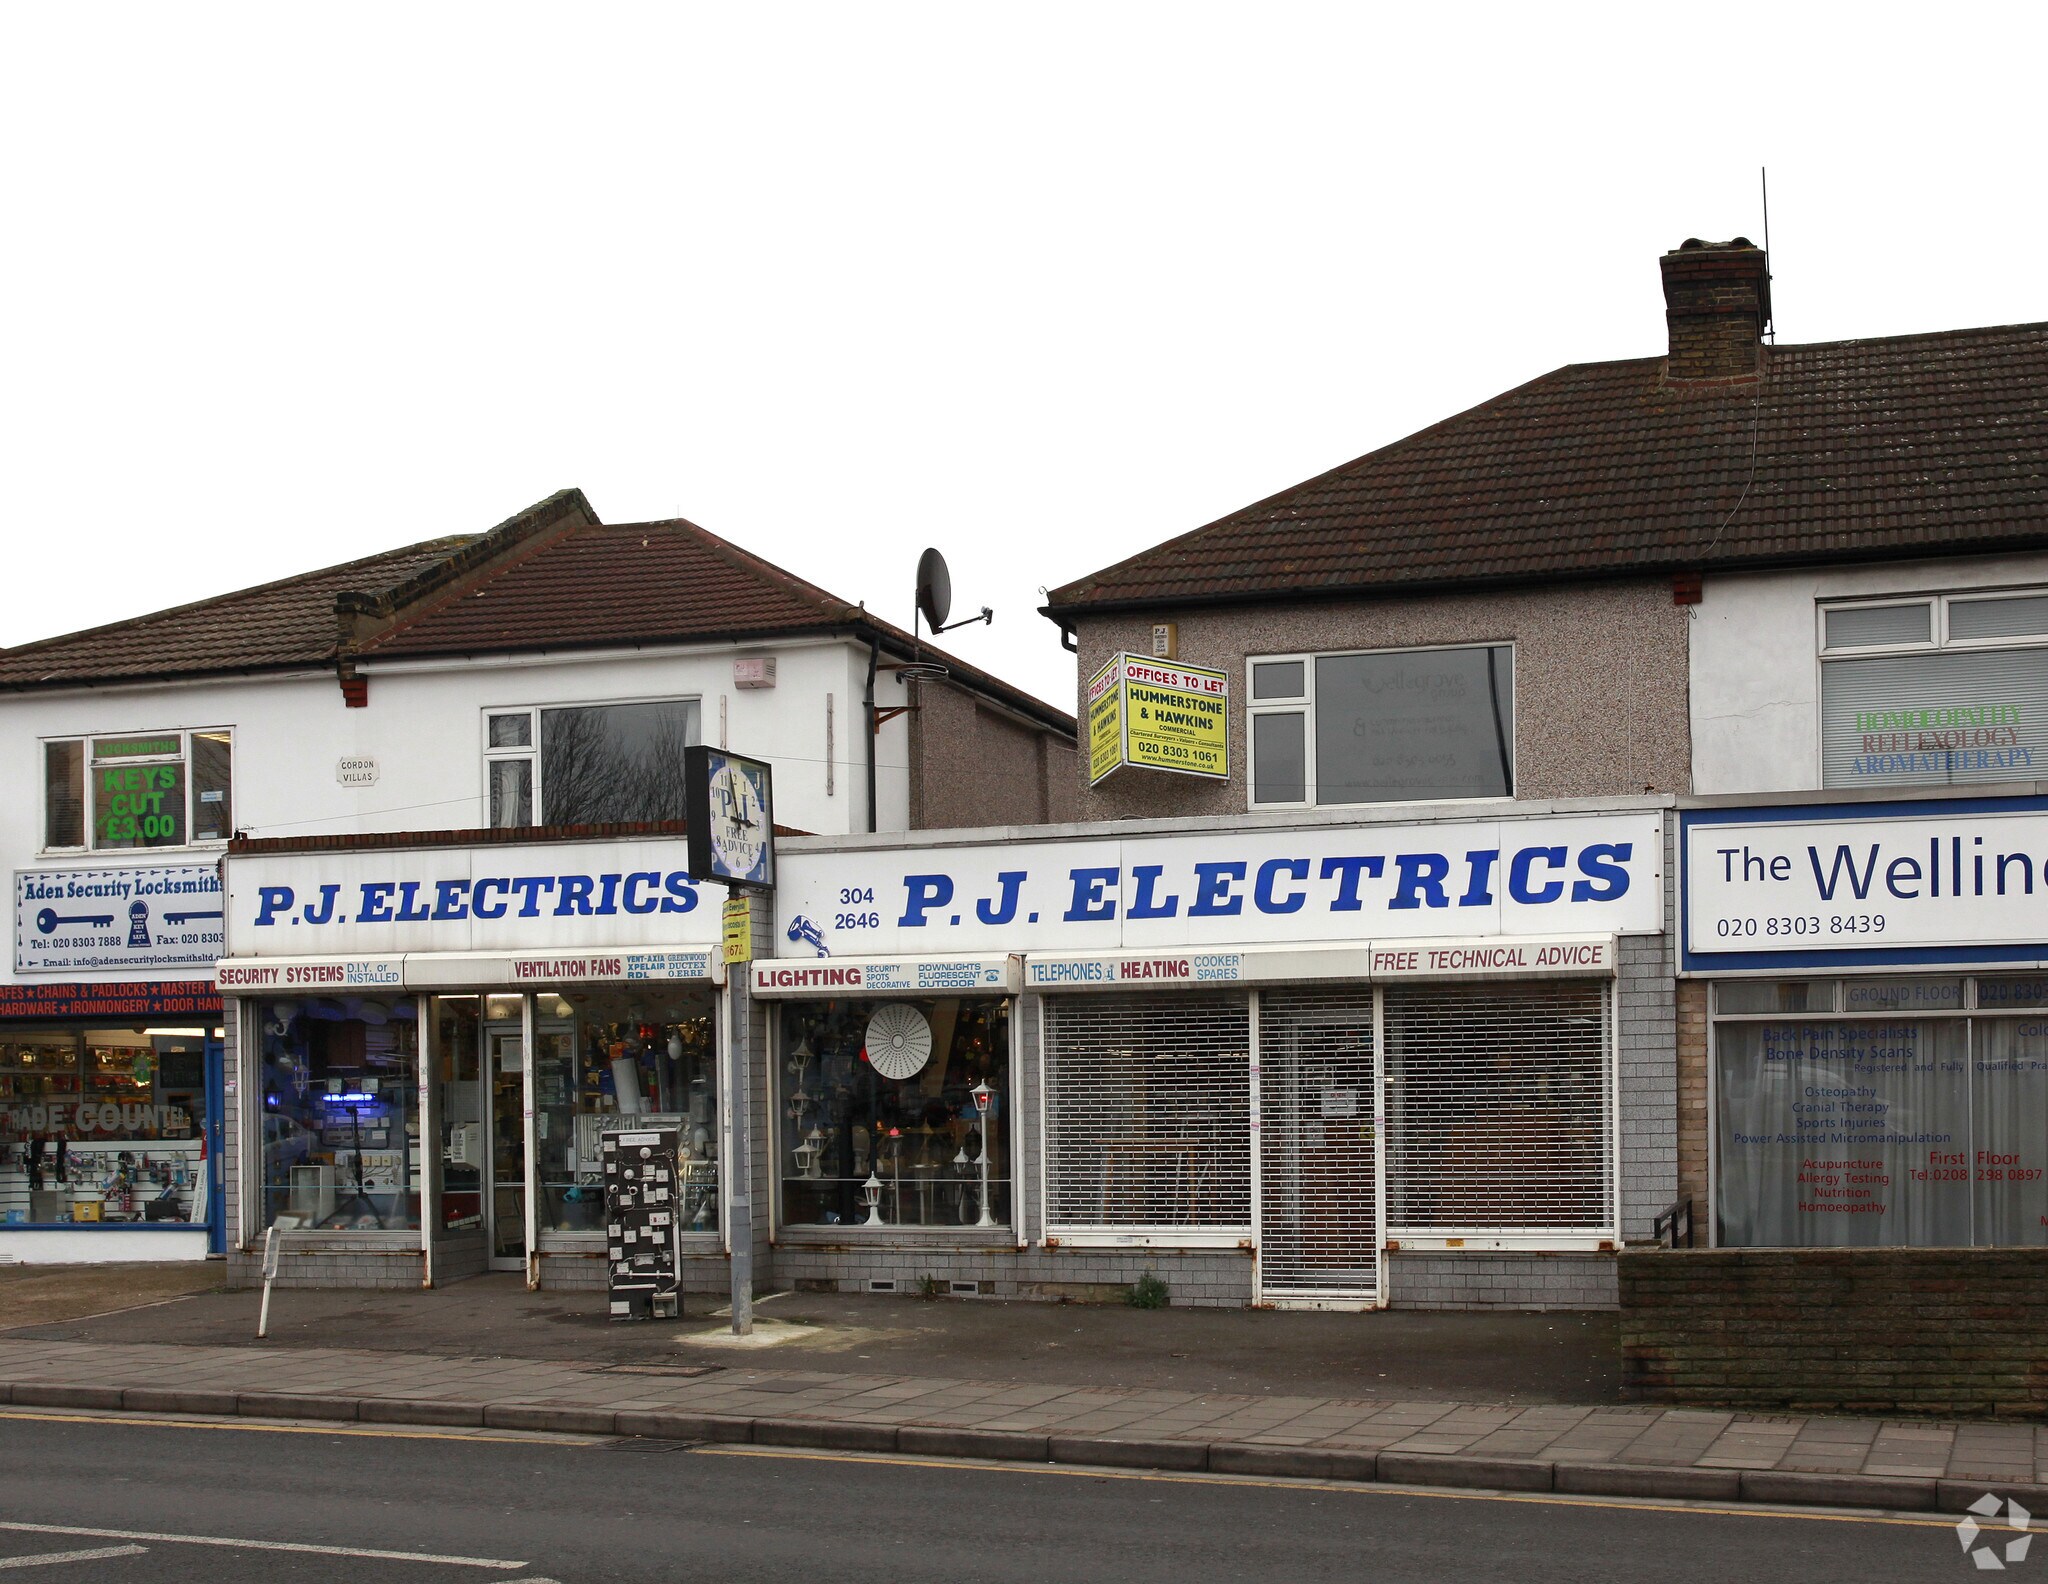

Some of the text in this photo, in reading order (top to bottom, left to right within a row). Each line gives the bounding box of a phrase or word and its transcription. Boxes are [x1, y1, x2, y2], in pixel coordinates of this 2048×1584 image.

[1127, 666, 1224, 692] OFFICES TO LET
[1130, 688, 1222, 714] HUMMERSTONE
[1140, 707, 1213, 730] & HAWKINS
[1129, 730, 1153, 738] Chartered
[1159, 724, 1196, 736] COMMERCIAL
[1862, 727, 2021, 753] REFLEXOLOGY
[97, 741, 177, 755] LOCKSMITHS
[1138, 741, 1217, 762] 020 8303 1061
[1141, 754, 1214, 769] www.hummerstone.co.uk
[1851, 747, 2035, 775] AROMATHERAPY
[103, 766, 176, 792] KEYS
[343, 773, 372, 781] VILLAS
[111, 791, 165, 816] CUT
[106, 815, 175, 840] £3.00
[726, 826, 748, 841] FREE
[722, 840, 753, 856] ADVICE
[1717, 836, 2048, 901] The Wellin
[1063, 842, 1633, 922] ELECTRICS
[24, 883, 64, 899] Aden
[67, 880, 131, 900] Security
[356, 870, 701, 923] ELECTRICS
[839, 888, 874, 904] 304
[834, 912, 880, 929] 2646
[1717, 914, 1886, 937] 020 8303 8439
[31, 936, 121, 949] Tel: 020 8303 7888
[156, 935, 178, 945] Fax:
[181, 934, 198, 944] 020
[43, 958, 71, 967] Email:
[627, 955, 665, 963] VENT-AXIA
[668, 953, 707, 961] GREENWOOD
[1194, 955, 1239, 967] COOKER
[1373, 945, 1603, 971] FREE TECHNICAL ADVICE
[347, 963, 388, 973] D.I.Y. or
[515, 958, 621, 978] VENTILATION FANS
[628, 963, 666, 971] XPELAIR
[668, 962, 706, 970] DUCTEX
[866, 964, 901, 973] SECURITY
[918, 963, 981, 972] DOWNLIGHTS
[1031, 962, 1102, 982] TELEPHONES
[1120, 959, 1190, 979] HEATING
[219, 965, 344, 985] SECURITY SYSTEMS
[347, 972, 399, 983] INSTALLED
[627, 971, 650, 979] RDL
[758, 967, 862, 987] LIGHTING
[866, 973, 889, 981] SPOTS
[918, 971, 981, 980] FLUORESCENT
[1197, 968, 1238, 980] SPARES
[37, 985, 76, 998] CHAINS
[80, 984, 88, 997] &
[91, 983, 147, 997] PADLOCKS
[161, 981, 206, 996] MASTER
[866, 981, 911, 989] DECORATIVE
[918, 979, 975, 988] OUTDOOR
[1849, 985, 1961, 1002] GROUND FLOOR
[1980, 985, 2008, 1000] 020
[70, 1001, 150, 1014] IRONMONGERY
[164, 998, 193, 1012] DOOR
[1763, 1025, 1918, 1043] Back Pain Specialists
[1766, 1046, 1913, 1063] Bone Density Scans
[1854, 1063, 1908, 1075] Registered
[1914, 1062, 1934, 1072] and
[1940, 1061, 1964, 1074] Fully
[1976, 1061, 2024, 1072] Qualified
[1805, 1085, 1877, 1100] Osteopathy
[1792, 1101, 1889, 1115] Cranial Therapy
[75, 1103, 184, 1132] COUNTER
[1796, 1117, 1886, 1130] Sports Injuries
[1734, 1131, 1951, 1146] Power Assisted Micromanipulation
[1803, 1158, 1883, 1172] Acupuncture
[1930, 1150, 2020, 1165] First Floor
[1797, 1171, 1889, 1187] Allergy Testing
[1910, 1168, 2042, 1181] Tel:0208 298 0897
[1814, 1187, 1871, 1198] Nutrition
[1798, 1200, 1887, 1215] Homoeopathy
